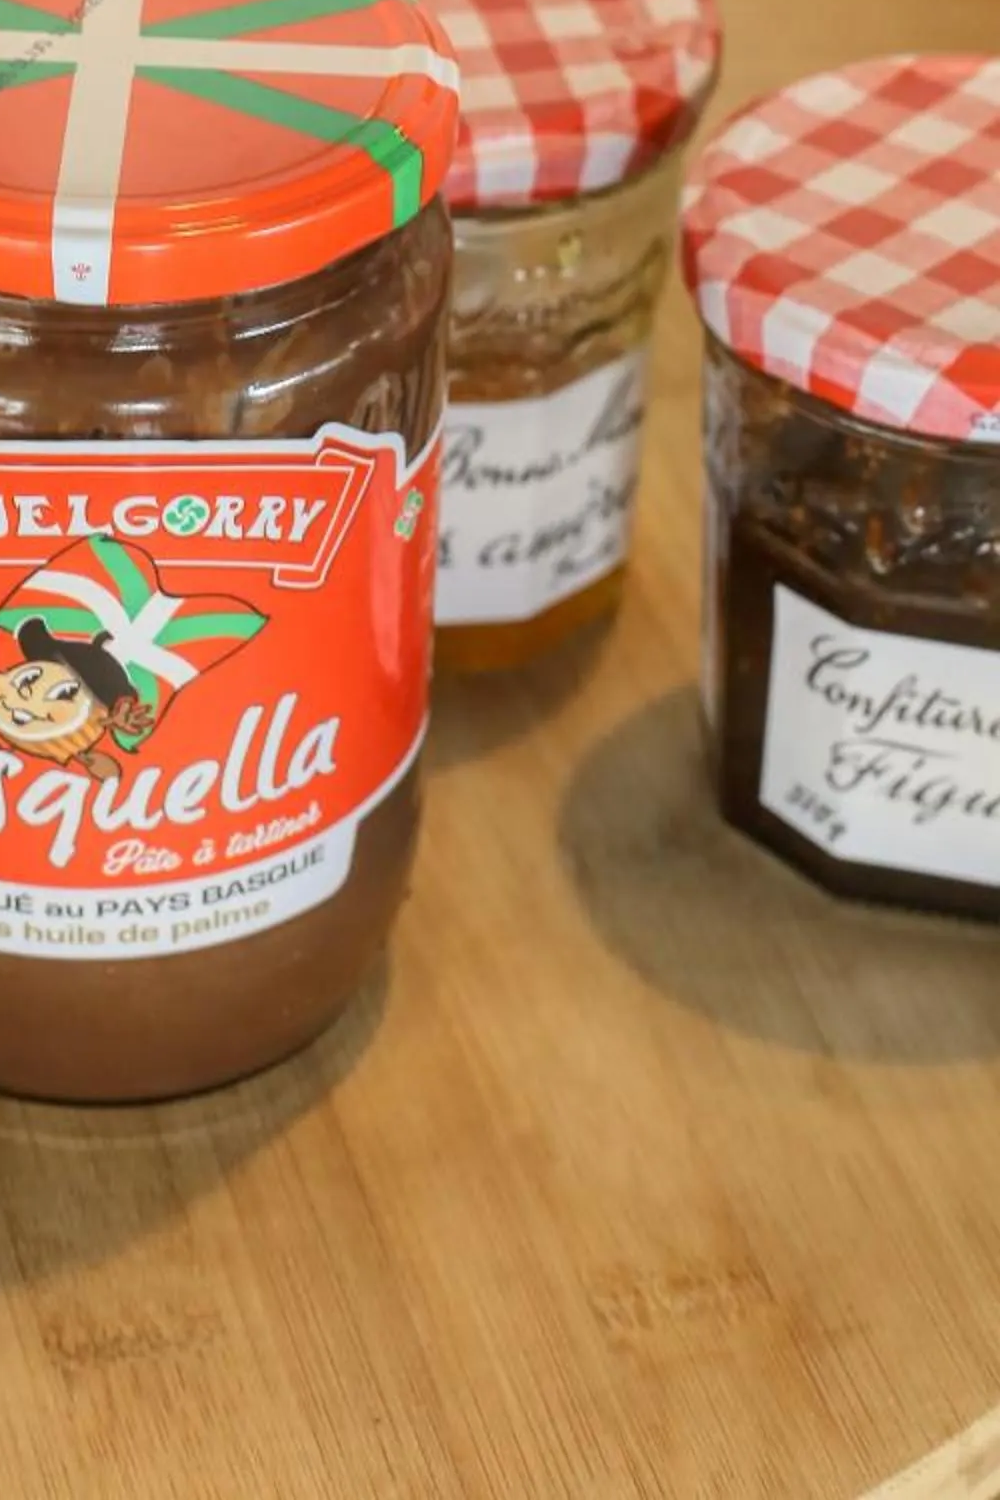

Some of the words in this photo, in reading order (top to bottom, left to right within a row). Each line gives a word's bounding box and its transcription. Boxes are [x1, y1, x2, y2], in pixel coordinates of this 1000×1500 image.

[45, 902, 84, 918] au
[96, 891, 191, 918] PAYS
[202, 843, 327, 905] BASQUE
[102, 838, 183, 877] Pâte
[24, 920, 106, 946] huile
[117, 924, 159, 945] de
[171, 898, 272, 944] palme
